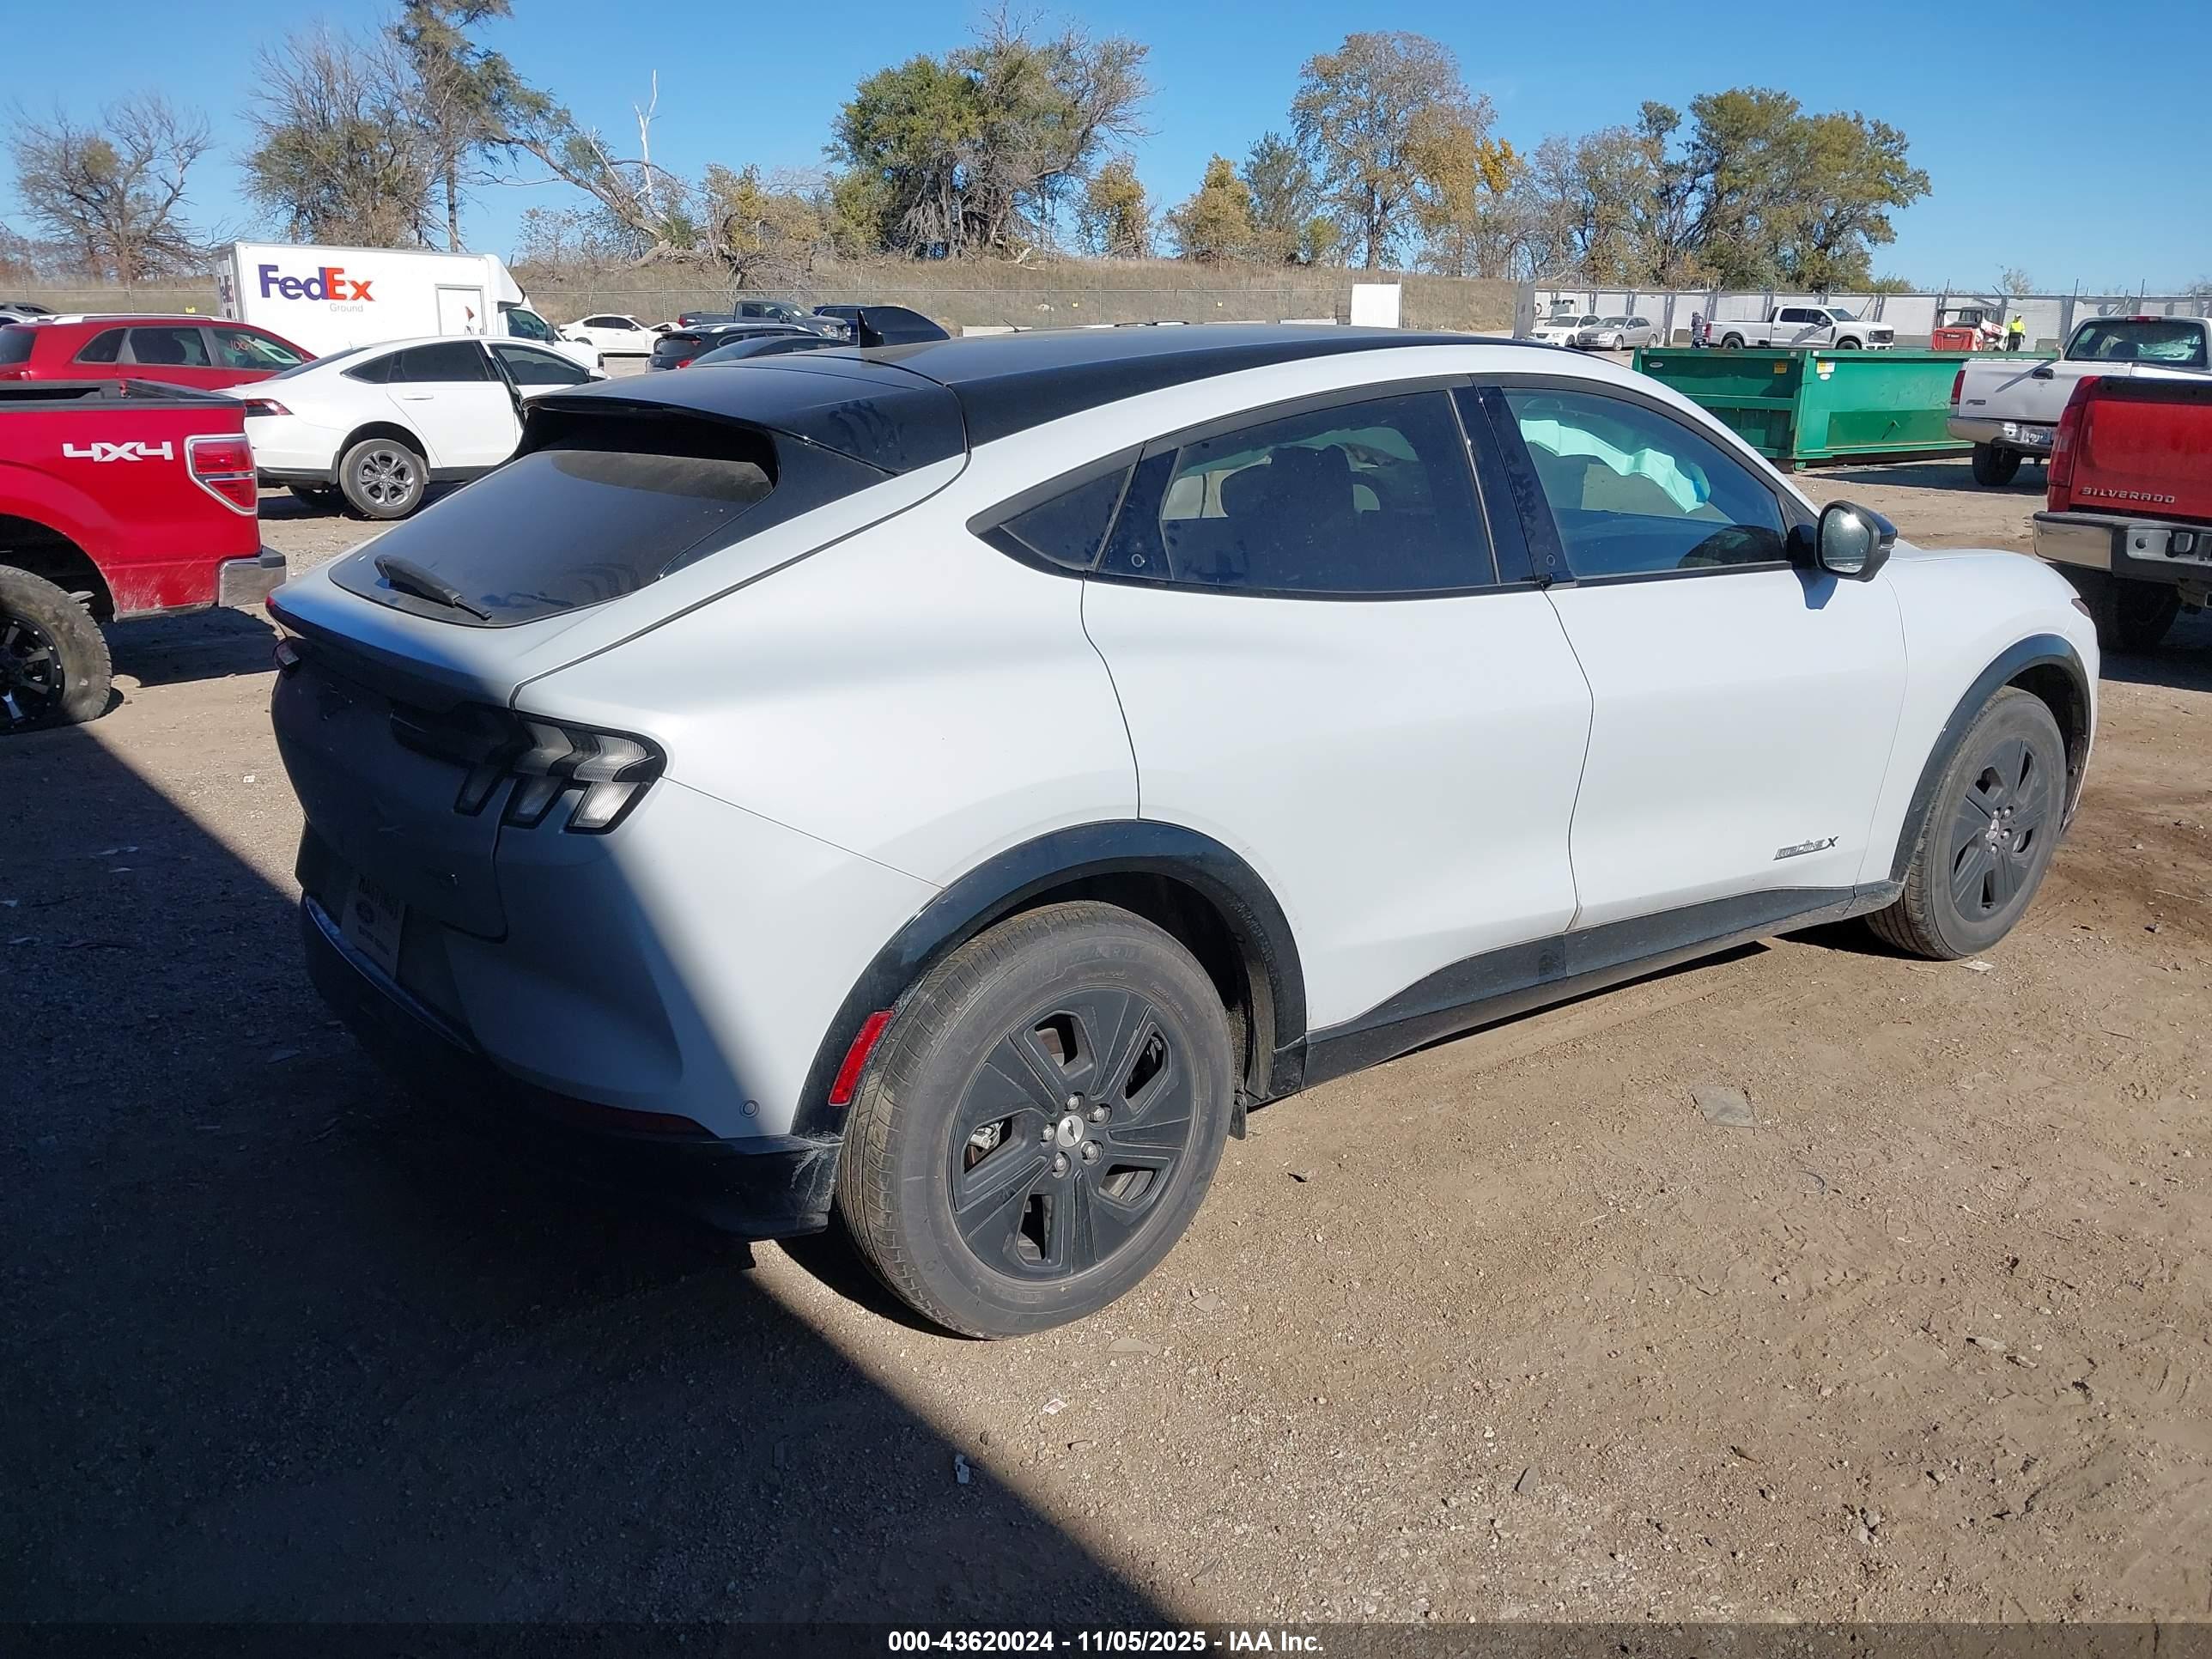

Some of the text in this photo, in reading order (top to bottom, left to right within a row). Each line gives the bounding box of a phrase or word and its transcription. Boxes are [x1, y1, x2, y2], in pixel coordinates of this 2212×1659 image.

[258, 264, 376, 301] FedEx
[330, 302, 364, 313] Ground
[2081, 487, 2175, 504] SILVERADO
